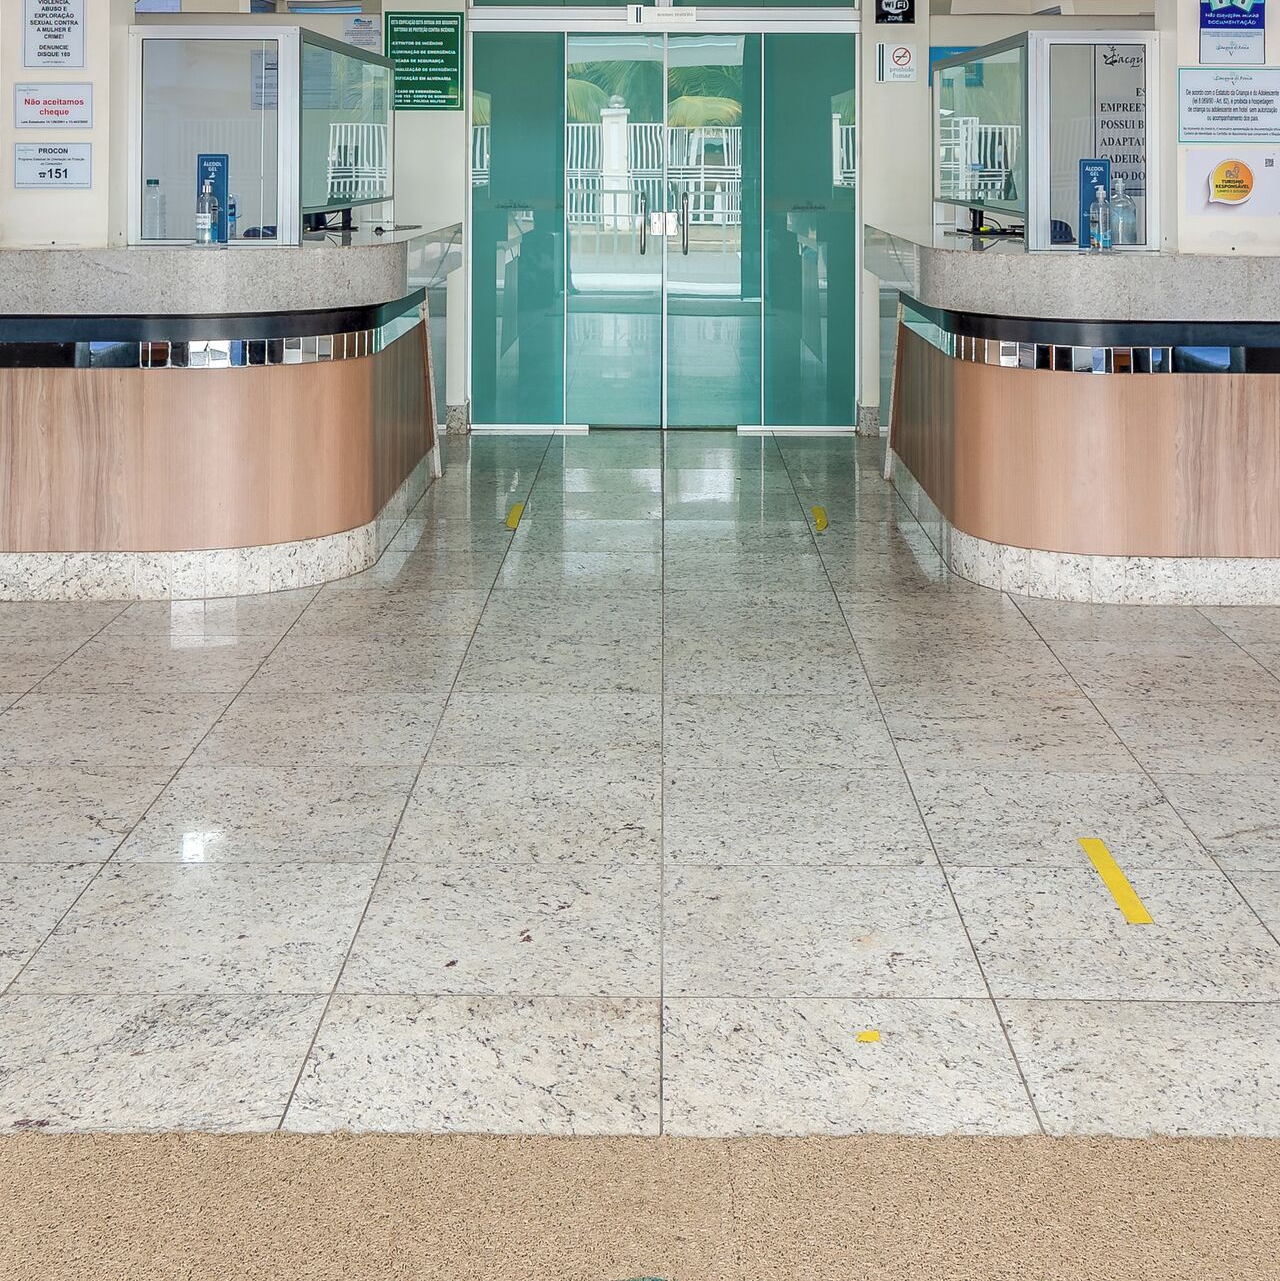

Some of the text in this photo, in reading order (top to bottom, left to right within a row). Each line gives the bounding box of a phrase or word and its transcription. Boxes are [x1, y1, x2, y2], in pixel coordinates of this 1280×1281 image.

[40, 108, 69, 117] cheque
[1101, 120, 1135, 129] POSSUI
[47, 168, 67, 178] 151
